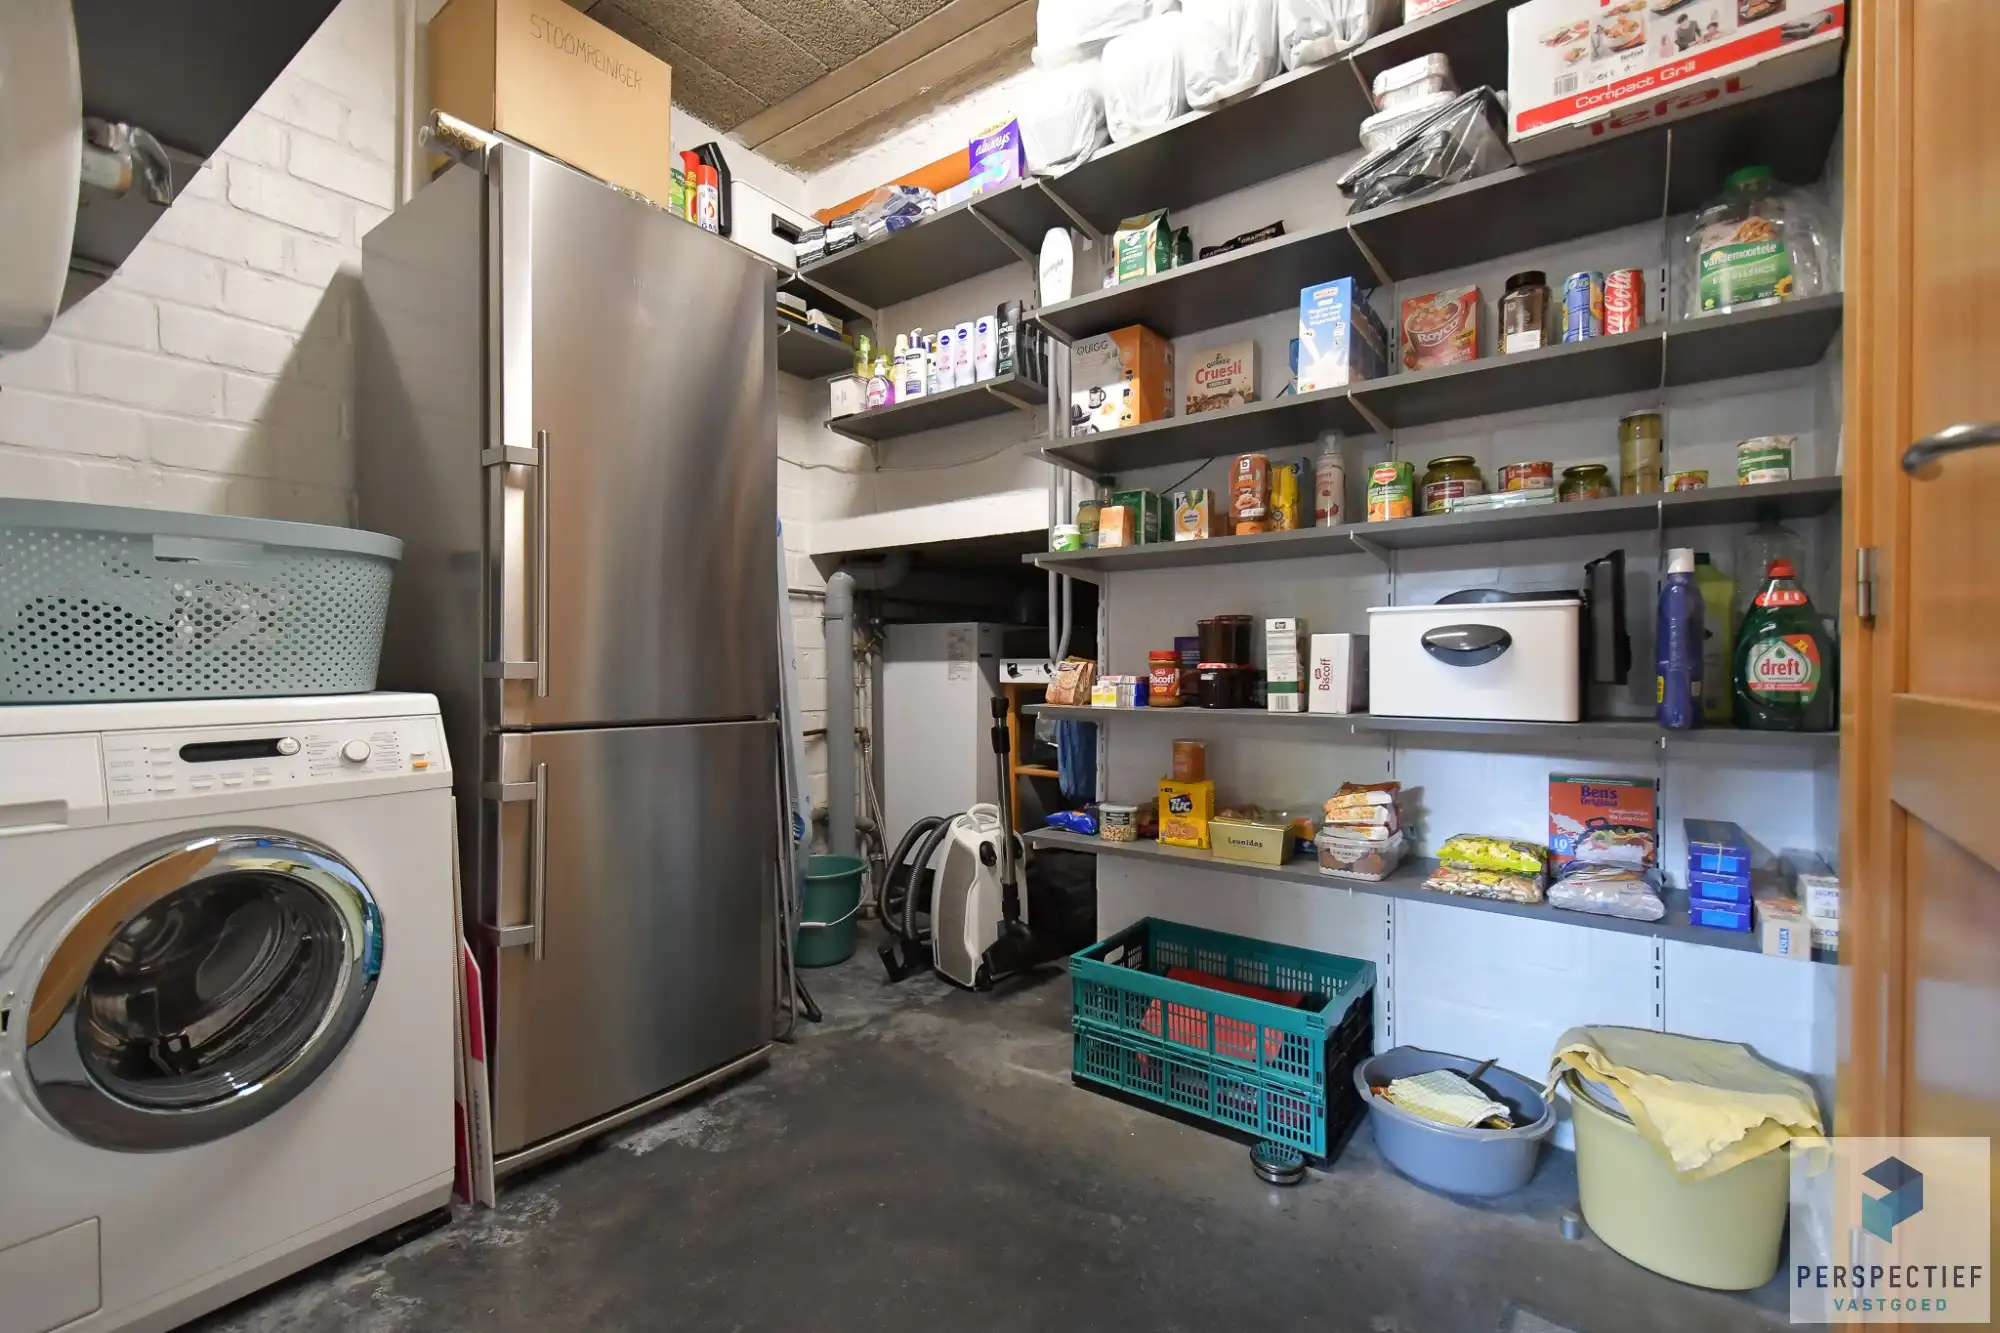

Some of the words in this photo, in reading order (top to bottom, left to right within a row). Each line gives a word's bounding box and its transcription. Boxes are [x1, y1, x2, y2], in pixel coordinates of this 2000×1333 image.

[529, 13, 643, 92] STOOMREINIGER
[1575, 76, 1655, 109] Compact
[1660, 60, 1697, 82] Grill
[975, 131, 1012, 157] always
[701, 222, 718, 233] GAS
[1076, 340, 1109, 356] QUIGG
[1195, 359, 1242, 385] Cruesli
[1318, 658, 1331, 692] Biscoff
[1761, 658, 1801, 676] dreft
[1149, 673, 1175, 684] Biscoff
[1581, 785, 1619, 799] Ben's
[1228, 837, 1264, 849] Leonidas
[1554, 837, 1568, 849] 10
